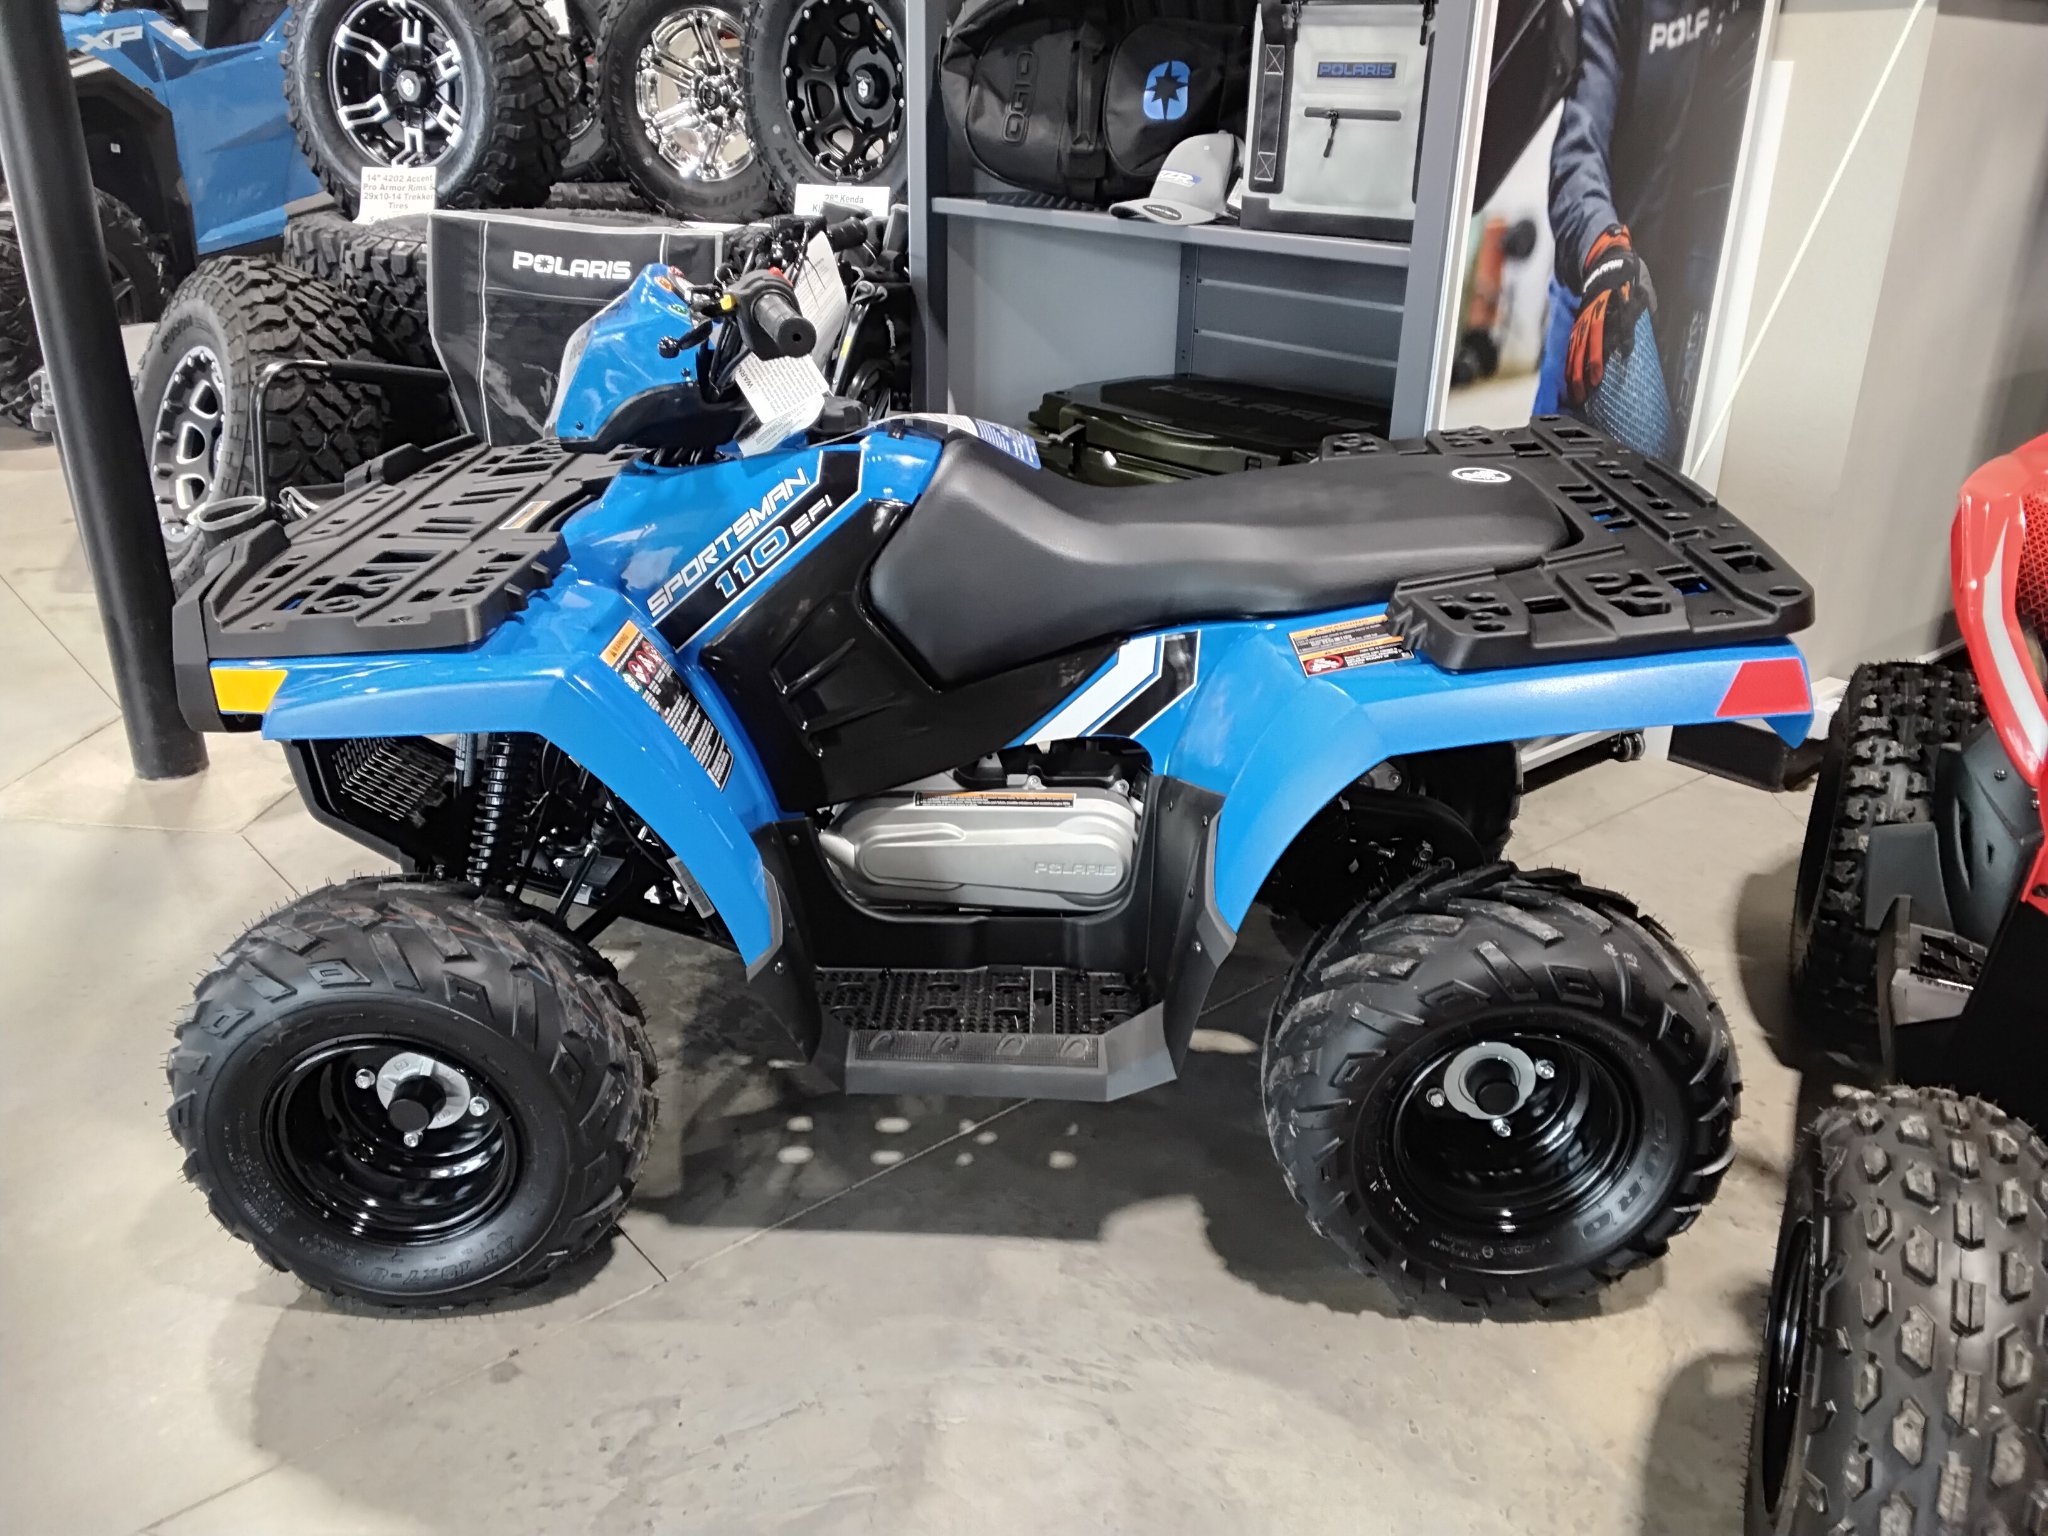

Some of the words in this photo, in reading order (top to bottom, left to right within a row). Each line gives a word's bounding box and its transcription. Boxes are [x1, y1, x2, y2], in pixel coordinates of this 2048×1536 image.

[75, 25, 143, 53] XP
[1319, 63, 1394, 76] POLARIS
[383, 174, 405, 182] 4202
[406, 174, 433, 182] Accent
[379, 183, 406, 191] Armor
[363, 192, 401, 200] 29x10-14
[839, 194, 864, 204] Kenda
[512, 250, 631, 280] POLARIS
[646, 467, 808, 618] SPORTSMAN
[715, 525, 790, 599] 110
[790, 494, 833, 537] EFI
[1034, 862, 1117, 876] POLARIS
